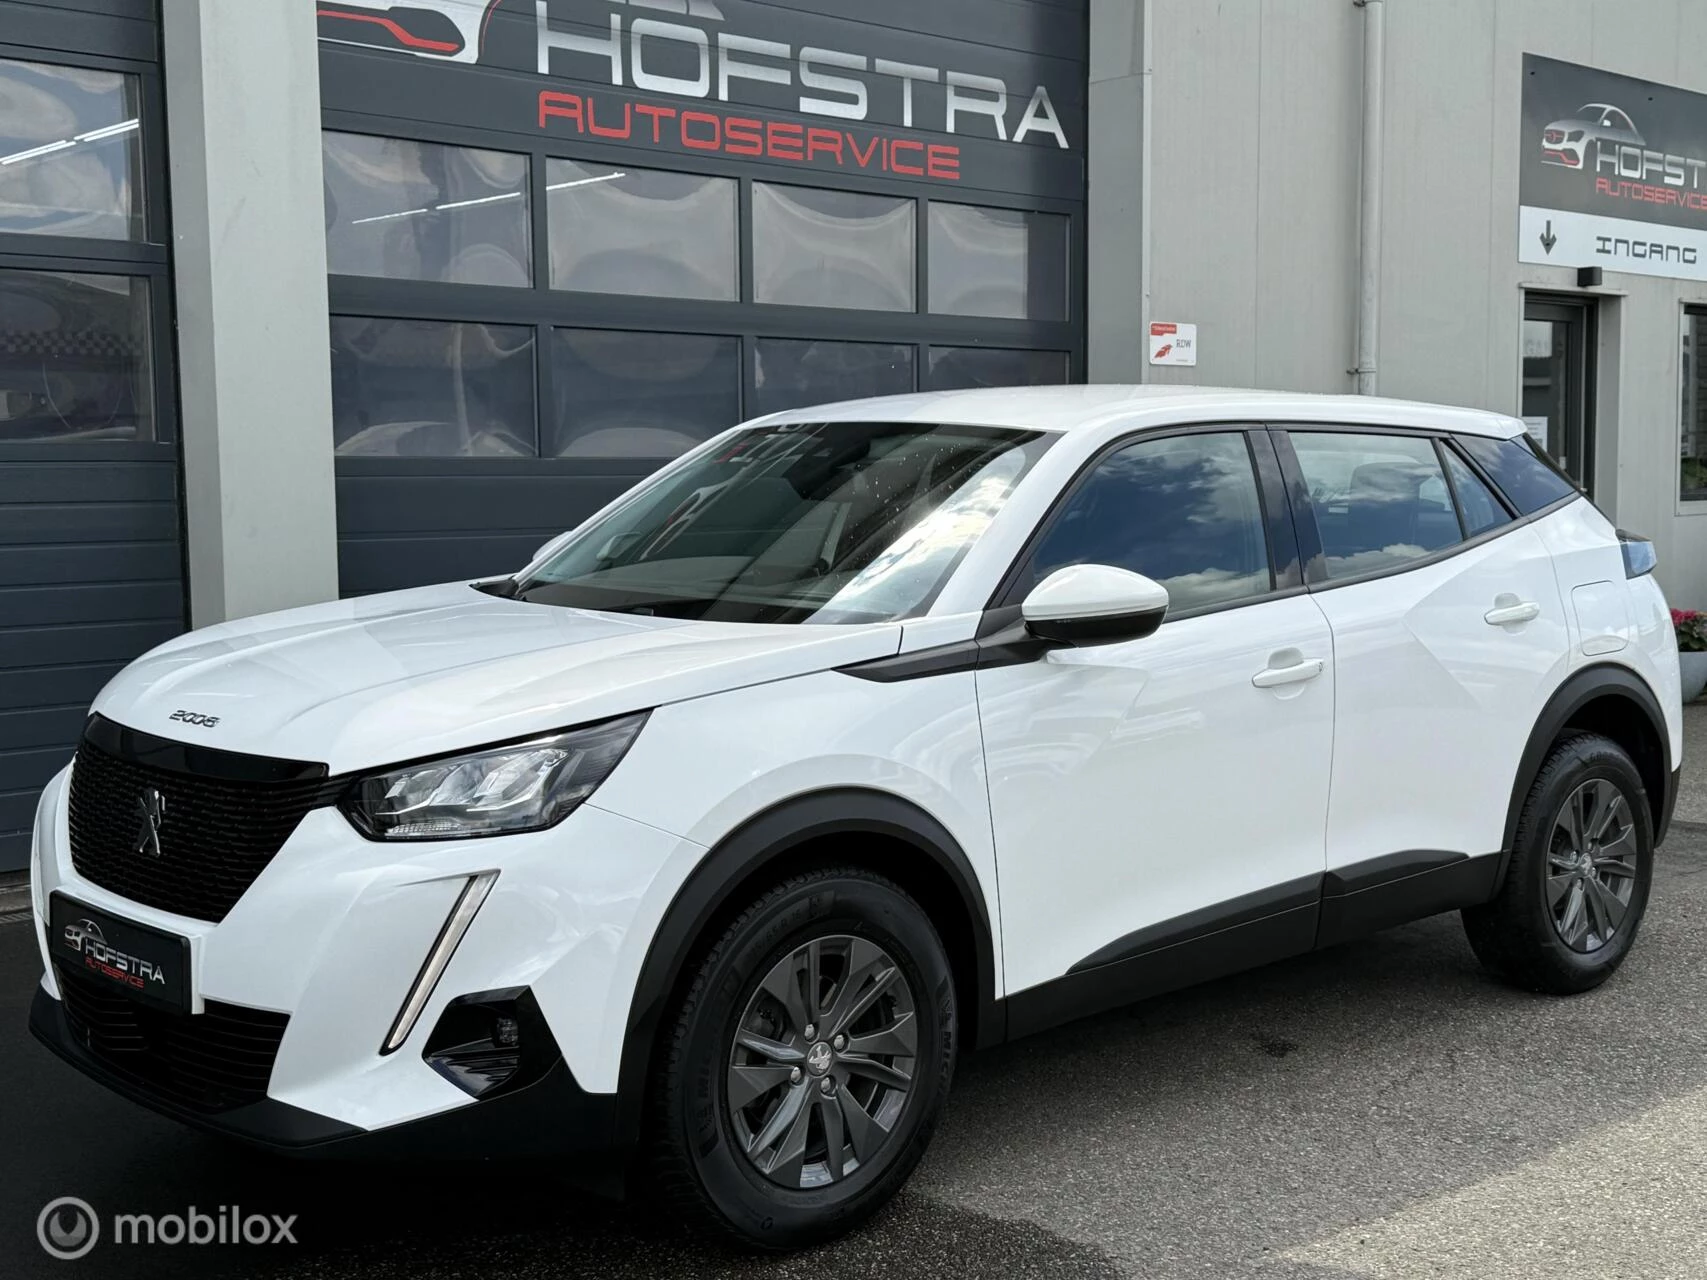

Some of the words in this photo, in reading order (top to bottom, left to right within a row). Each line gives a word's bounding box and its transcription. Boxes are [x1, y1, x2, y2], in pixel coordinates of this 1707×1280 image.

[535, 0, 1069, 149] HOFSTRA
[538, 90, 960, 180] AUTOSERVICE
[1596, 141, 1707, 189] HOFST
[1596, 236, 1697, 264] INGANG
[85, 936, 166, 985] HOFSTRA
